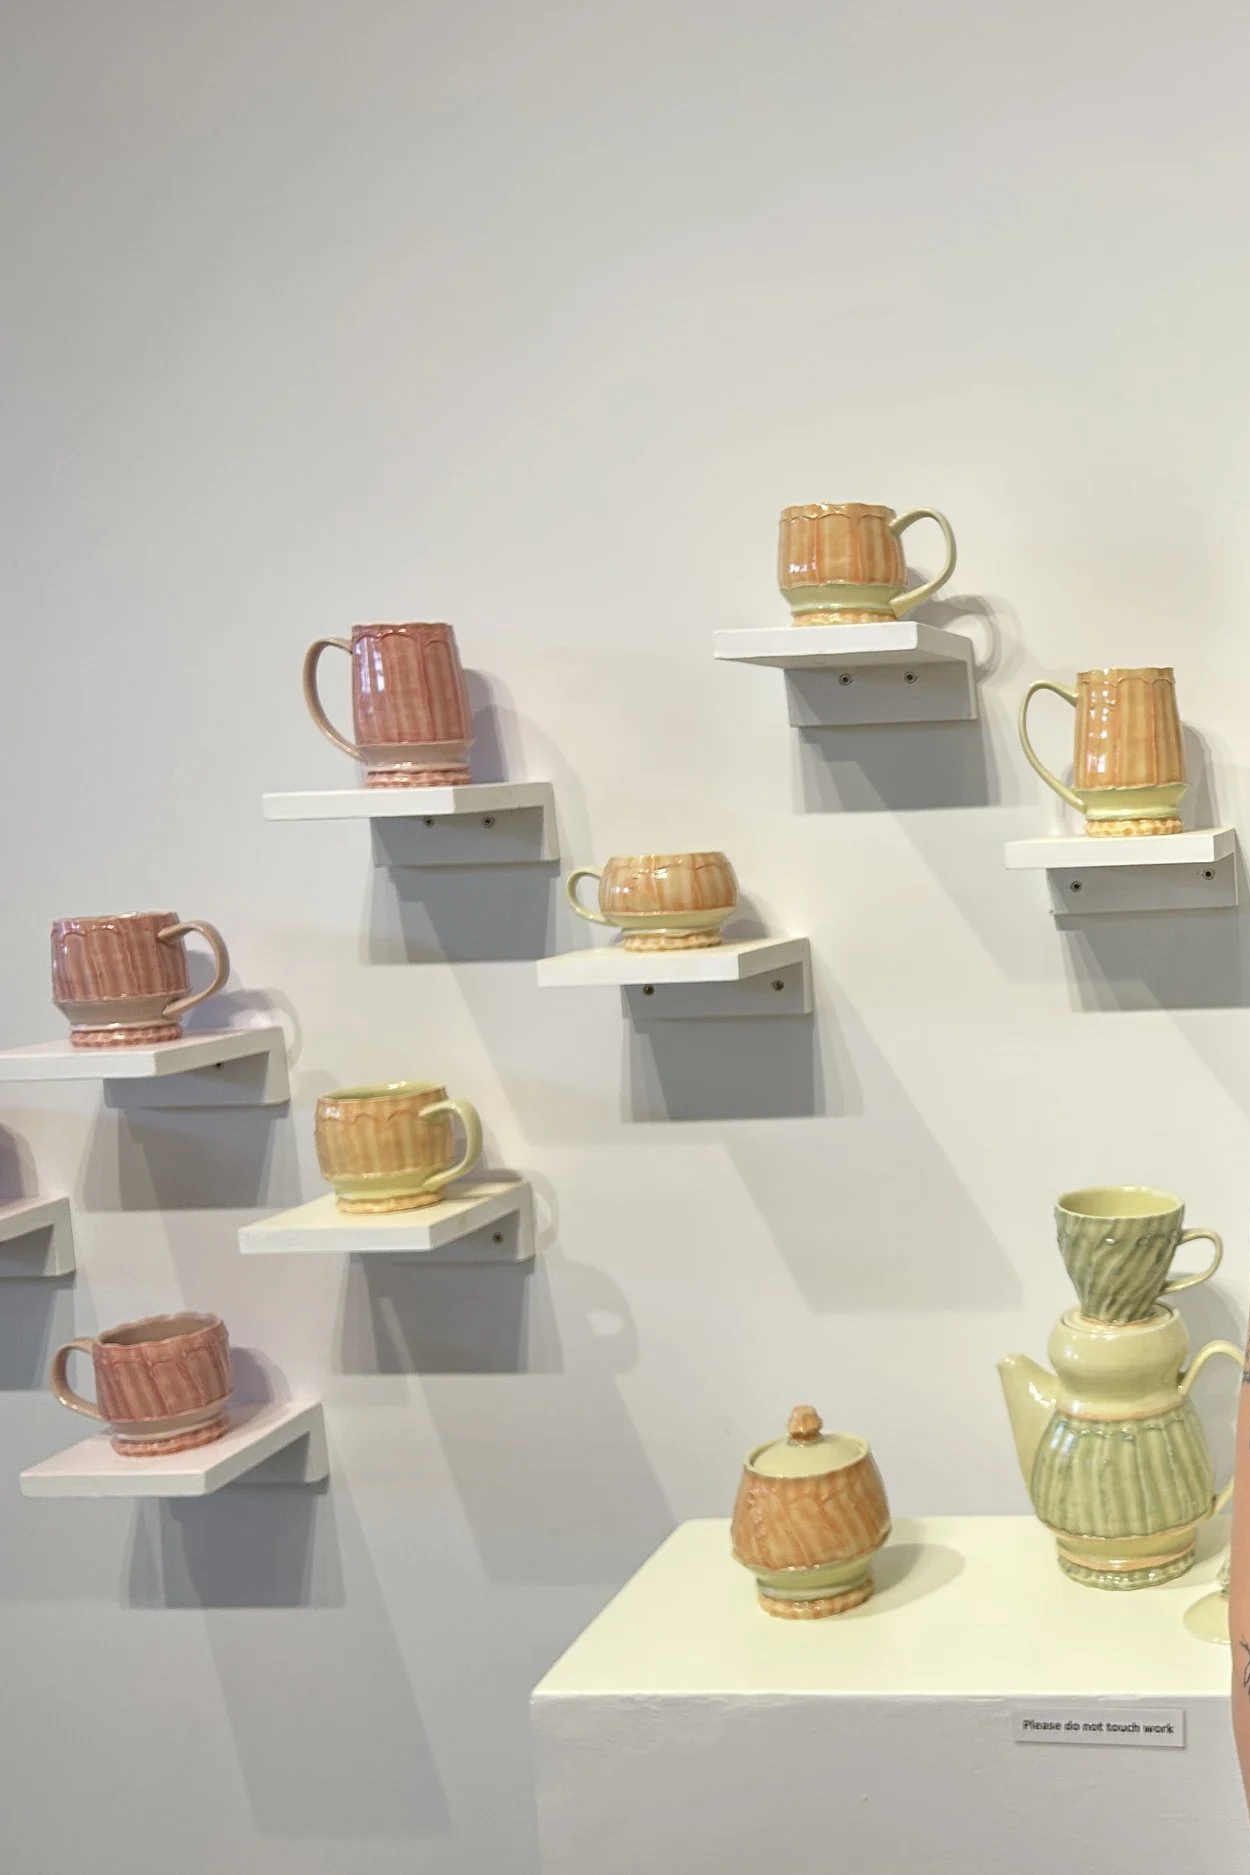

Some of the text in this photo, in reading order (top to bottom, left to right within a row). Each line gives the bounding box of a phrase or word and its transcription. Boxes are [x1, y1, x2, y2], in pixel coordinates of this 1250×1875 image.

[1022, 1719, 1175, 1734] Please do not touch work
